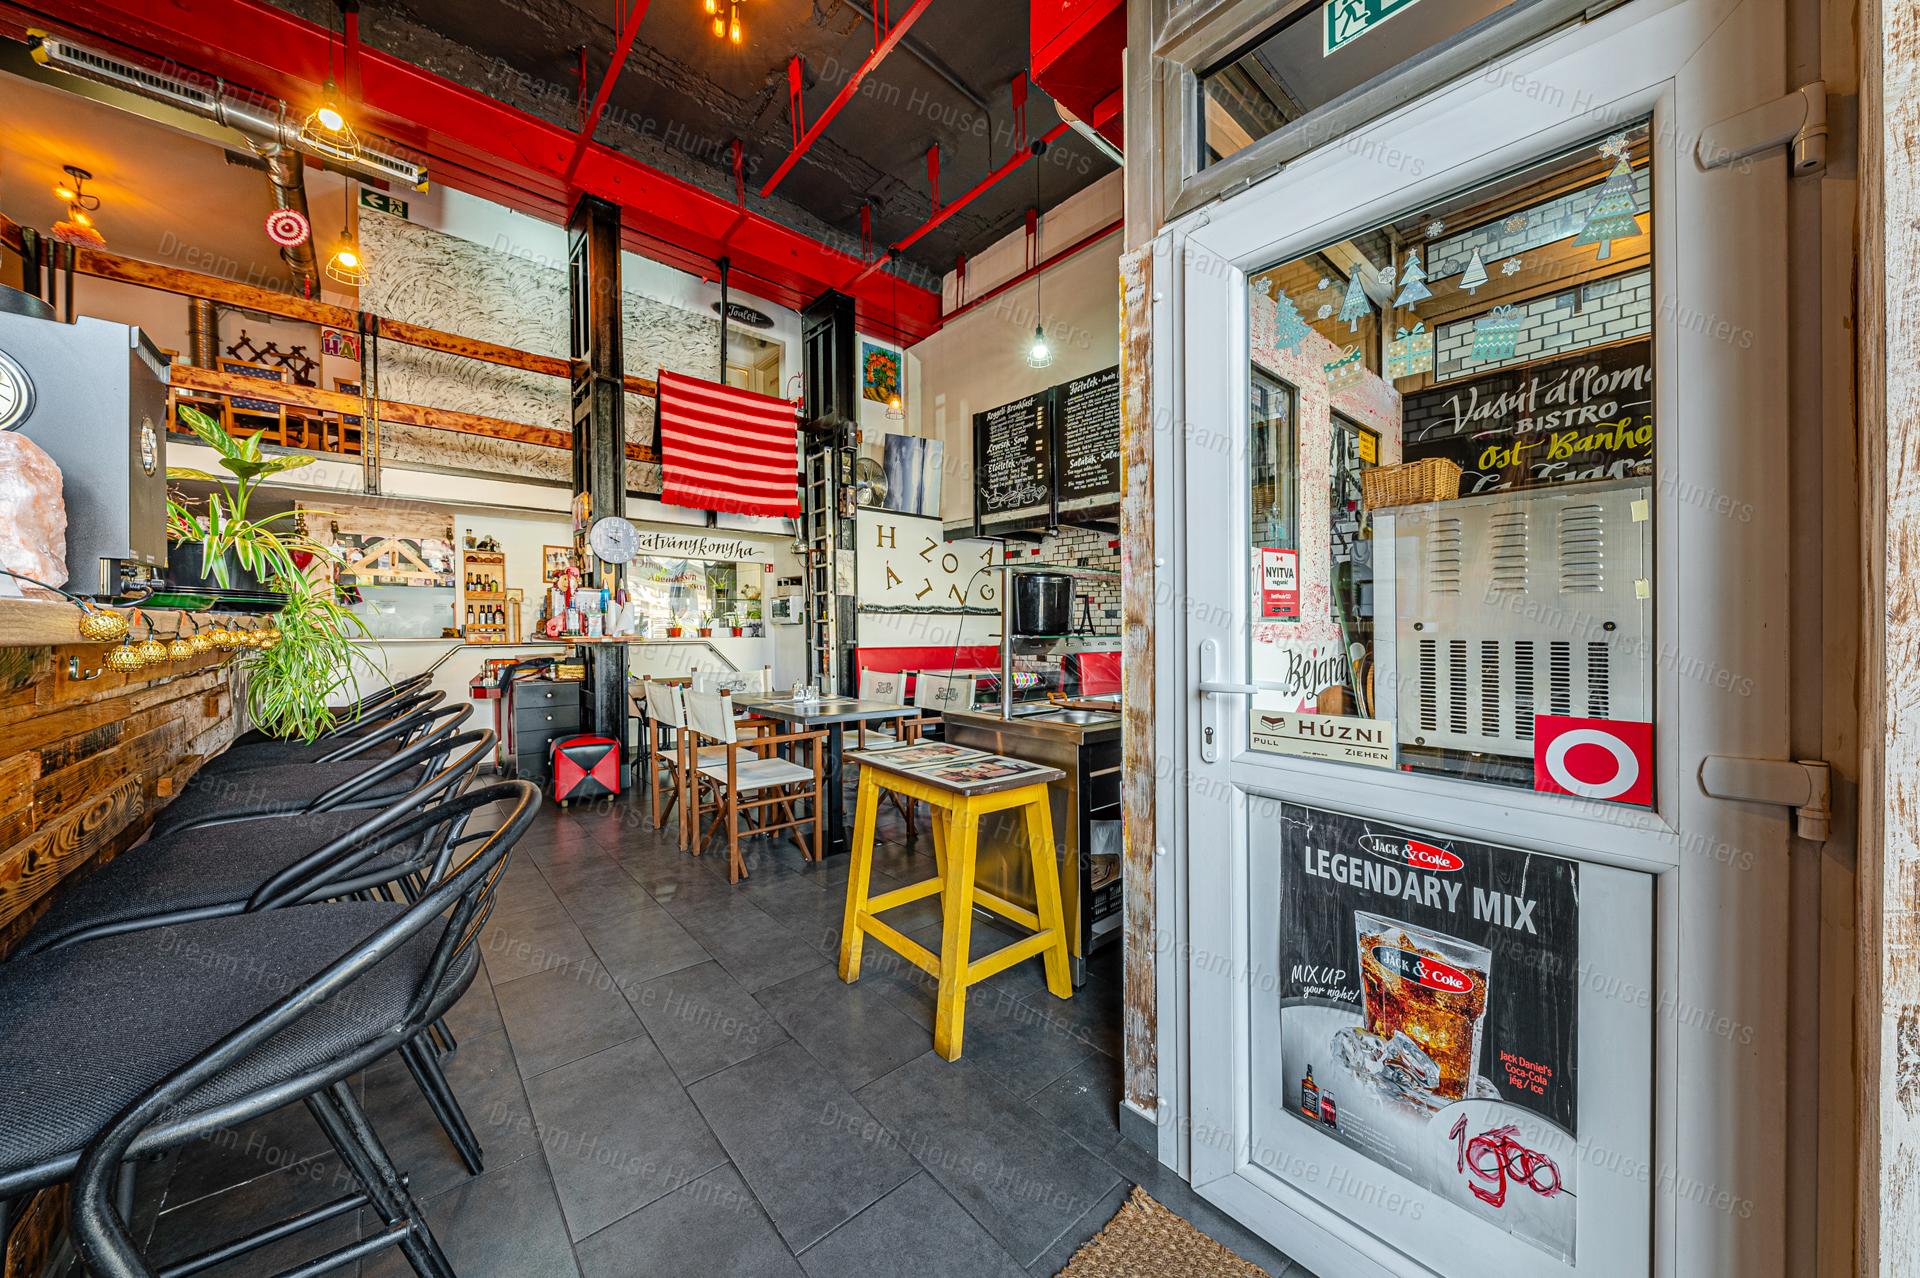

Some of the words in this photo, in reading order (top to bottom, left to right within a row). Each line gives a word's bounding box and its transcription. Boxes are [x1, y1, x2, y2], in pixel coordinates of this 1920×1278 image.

[1514, 401, 1619, 435] BISTRO
[1265, 566, 1295, 579] NYITVA
[1253, 736, 1280, 747] PULL
[1298, 719, 1383, 744] HÚZNI
[1344, 747, 1389, 761] ZIEHEN
[1305, 845, 1463, 914] LEGENDARY
[1473, 886, 1538, 936] MIX
[1291, 963, 1318, 985] MIX
[1321, 969, 1347, 986] UP
[1303, 985, 1326, 999] your
[1326, 984, 1361, 1004] night!
[1500, 1048, 1518, 1065] Jack
[1518, 1056, 1553, 1078] Daniel's
[1505, 1061, 1548, 1087] Coca-Cola
[1530, 1081, 1544, 1096] ice
